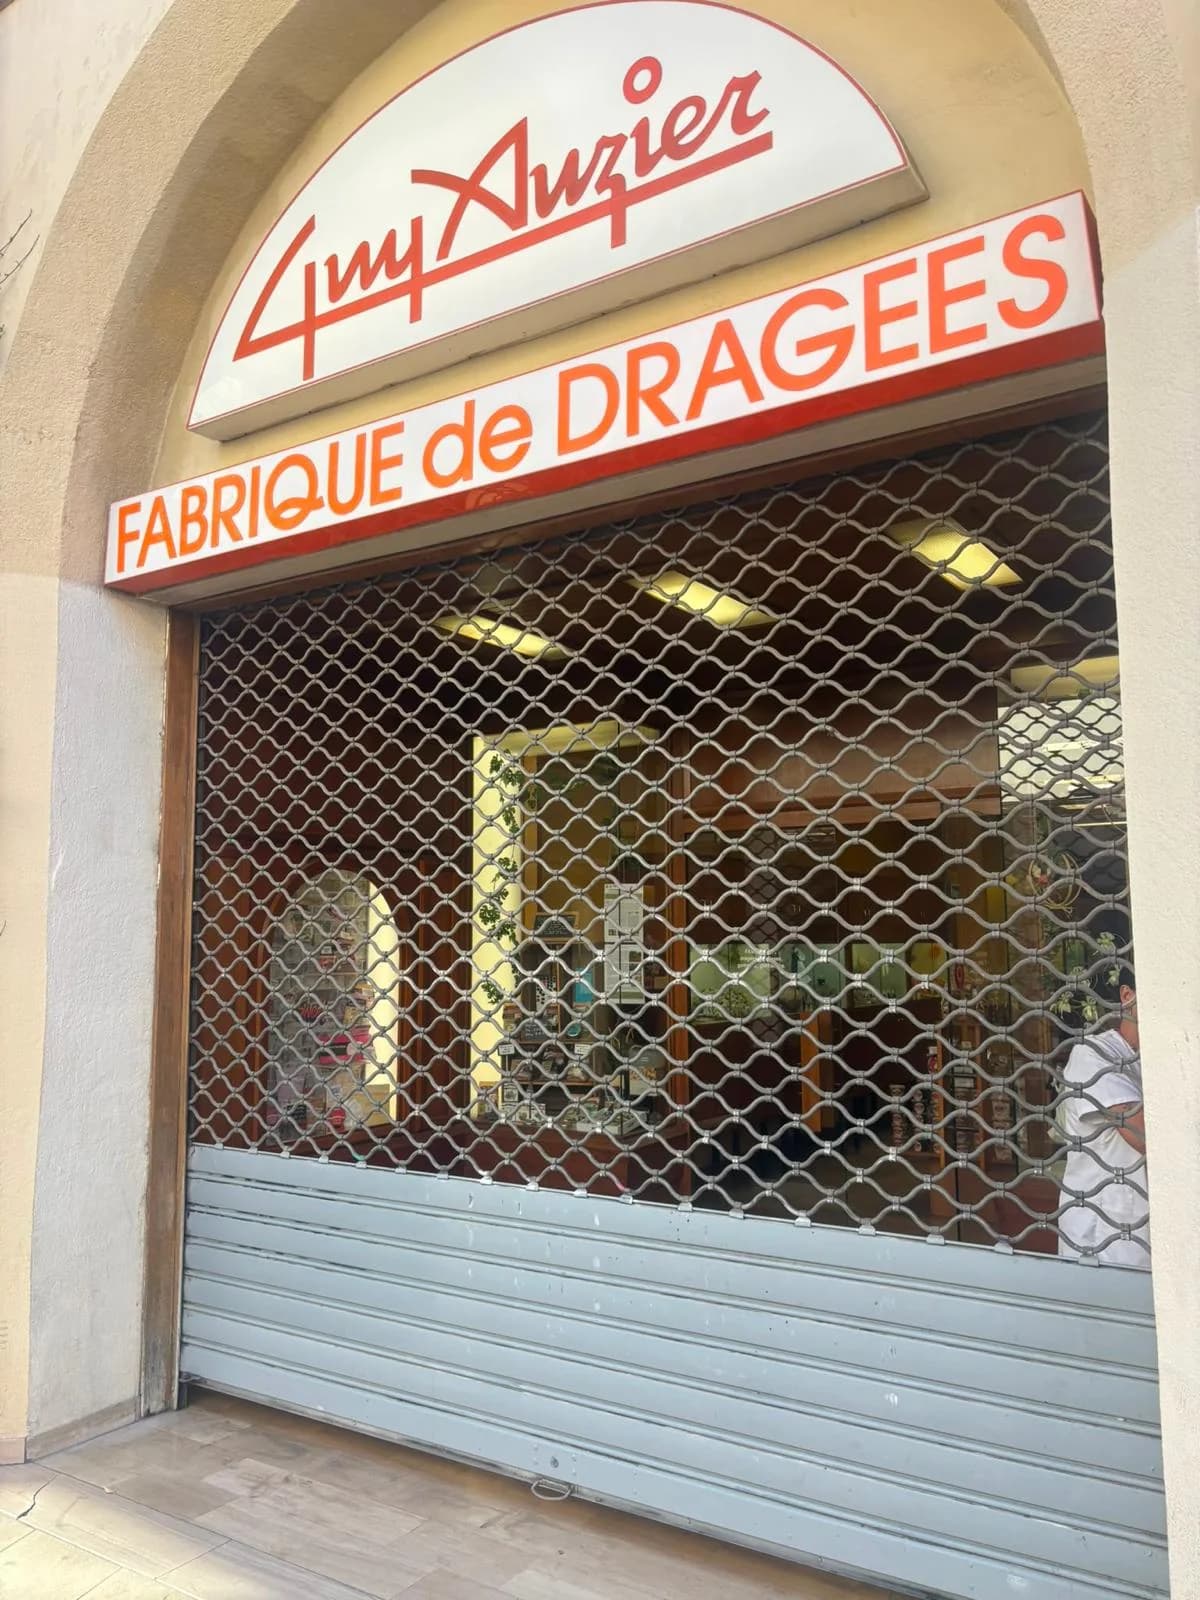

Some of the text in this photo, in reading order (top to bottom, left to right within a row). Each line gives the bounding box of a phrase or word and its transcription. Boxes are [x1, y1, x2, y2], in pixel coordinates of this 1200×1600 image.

[232, 55, 773, 381] Guy Auzier
[117, 215, 1069, 574] FABRIQUE de DRAGEES
